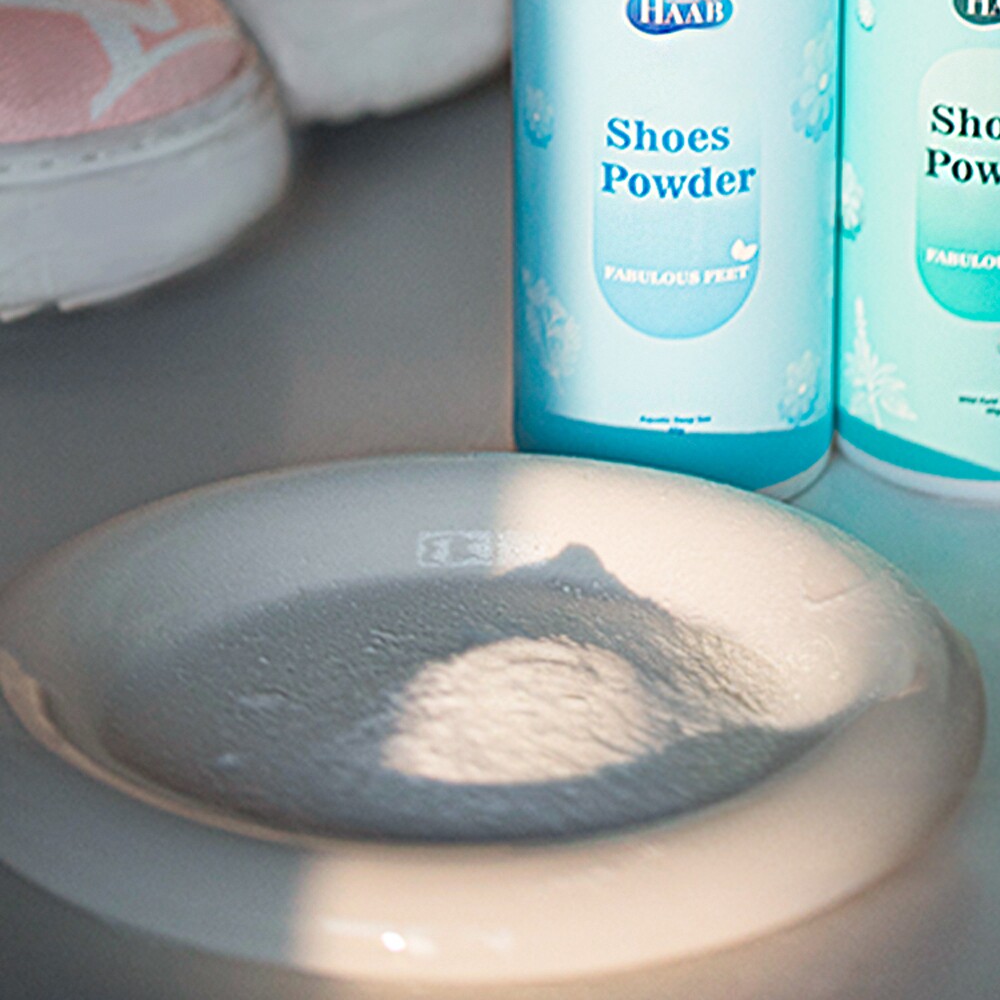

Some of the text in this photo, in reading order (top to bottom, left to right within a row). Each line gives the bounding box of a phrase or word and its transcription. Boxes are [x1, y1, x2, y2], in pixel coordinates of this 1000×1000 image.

[606, 116, 731, 154] Shoes
[600, 161, 757, 199] Powder
[604, 264, 750, 285] FABULOUS FEET
